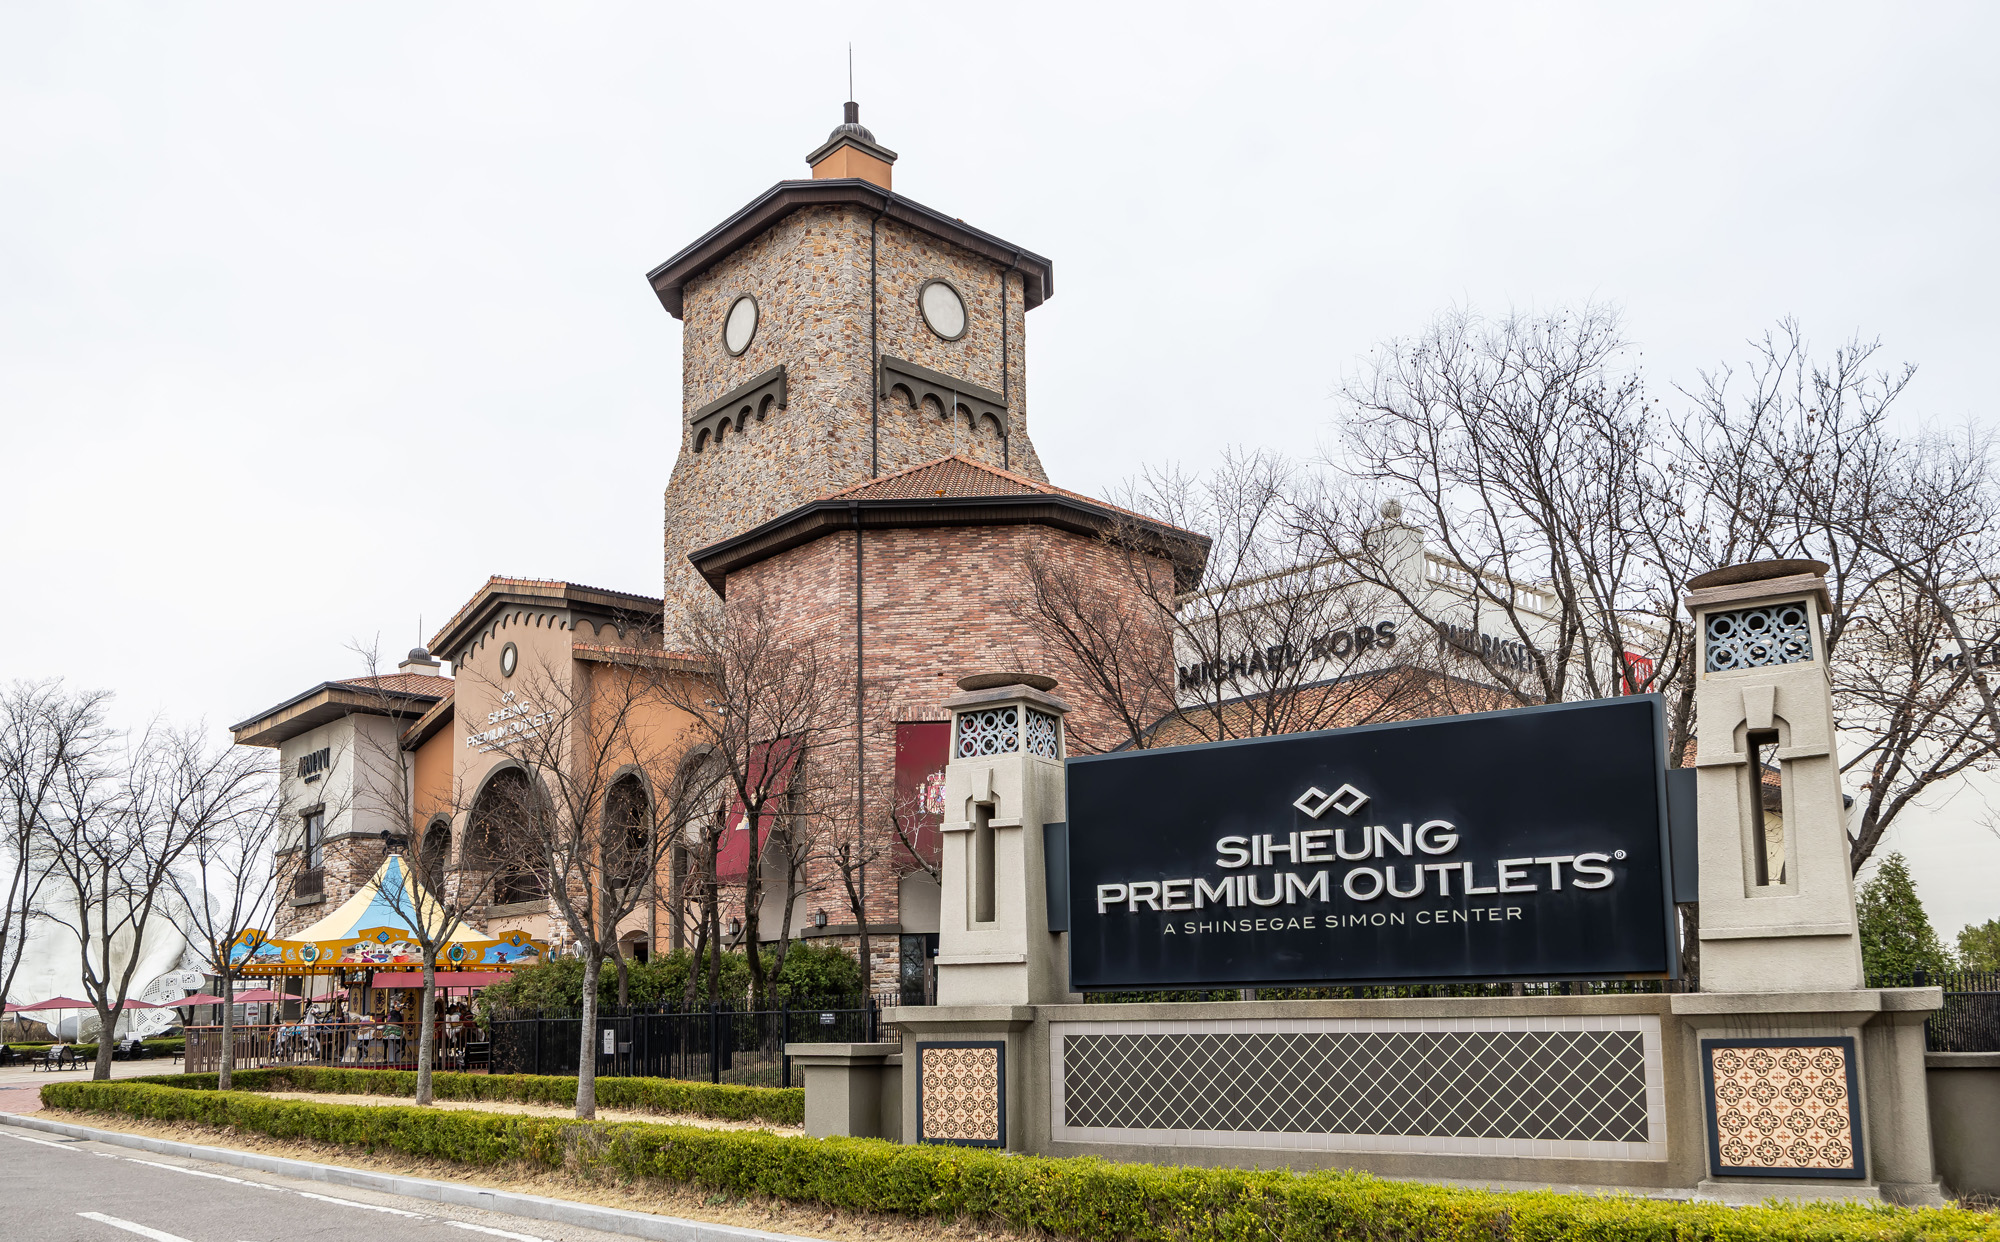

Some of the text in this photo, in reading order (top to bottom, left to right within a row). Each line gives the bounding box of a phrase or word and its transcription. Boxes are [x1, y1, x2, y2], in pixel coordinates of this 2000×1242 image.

[1312, 620, 1397, 664] KORS
[466, 725, 509, 749] PREMIUM
[1215, 819, 1459, 869] SIHEUNG
[1097, 870, 1330, 914] PREMIUM
[1163, 907, 1524, 935] A SHINSEGAE SIMON CENTER
